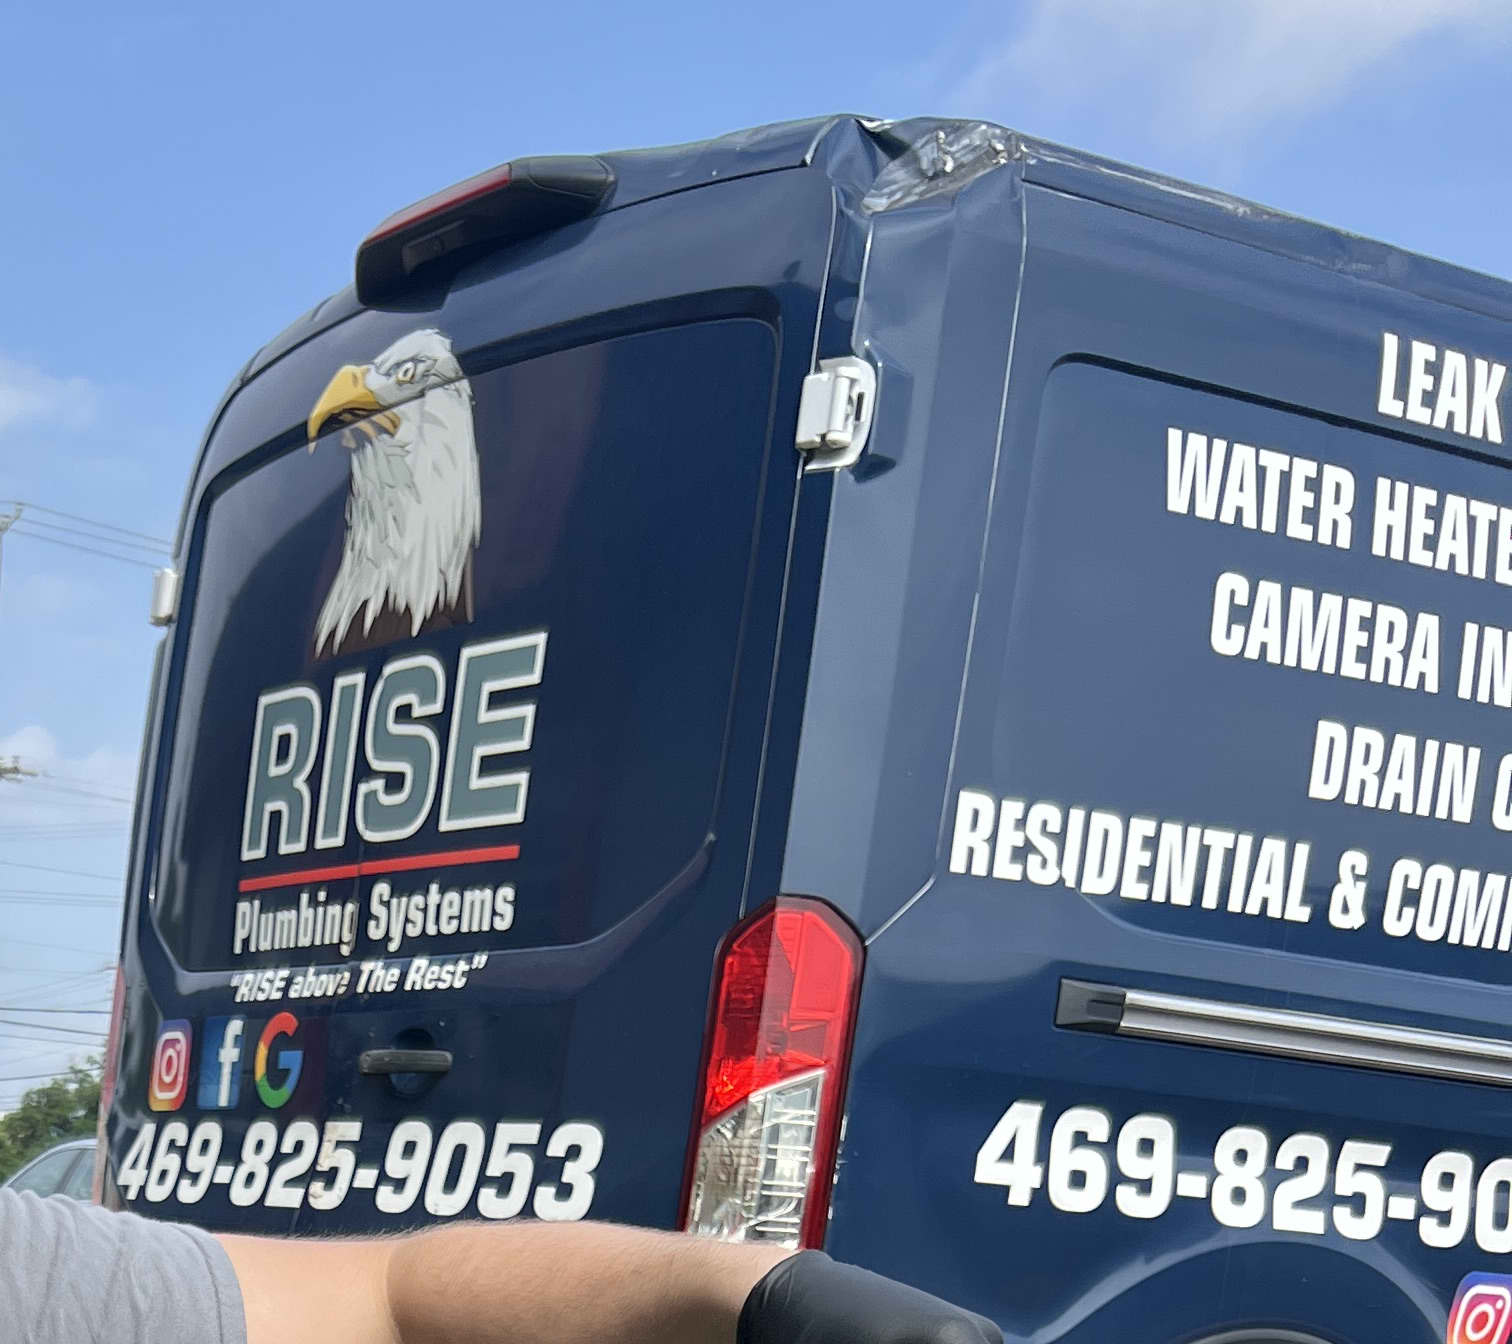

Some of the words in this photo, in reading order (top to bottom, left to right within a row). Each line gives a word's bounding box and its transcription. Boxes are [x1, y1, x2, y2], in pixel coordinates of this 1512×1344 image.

[1377, 332, 1507, 444] LEAK
[1166, 426, 1355, 549] WATER
[1371, 476, 1512, 587] HEATE
[1210, 571, 1440, 694] CAMERA
[1457, 621, 1512, 708] IN
[240, 631, 549, 861] RISE
[1308, 719, 1481, 824] DRAIN
[233, 888, 359, 957] Plumbing
[367, 880, 516, 952] Systems
[949, 788, 1313, 923] RESIDENTIAL
[1328, 849, 1369, 931] &
[288, 966, 350, 999] above
[356, 960, 400, 994] The
[117, 1118, 604, 1222] 469-825-9053
[974, 1099, 1512, 1254] 469-825-90
